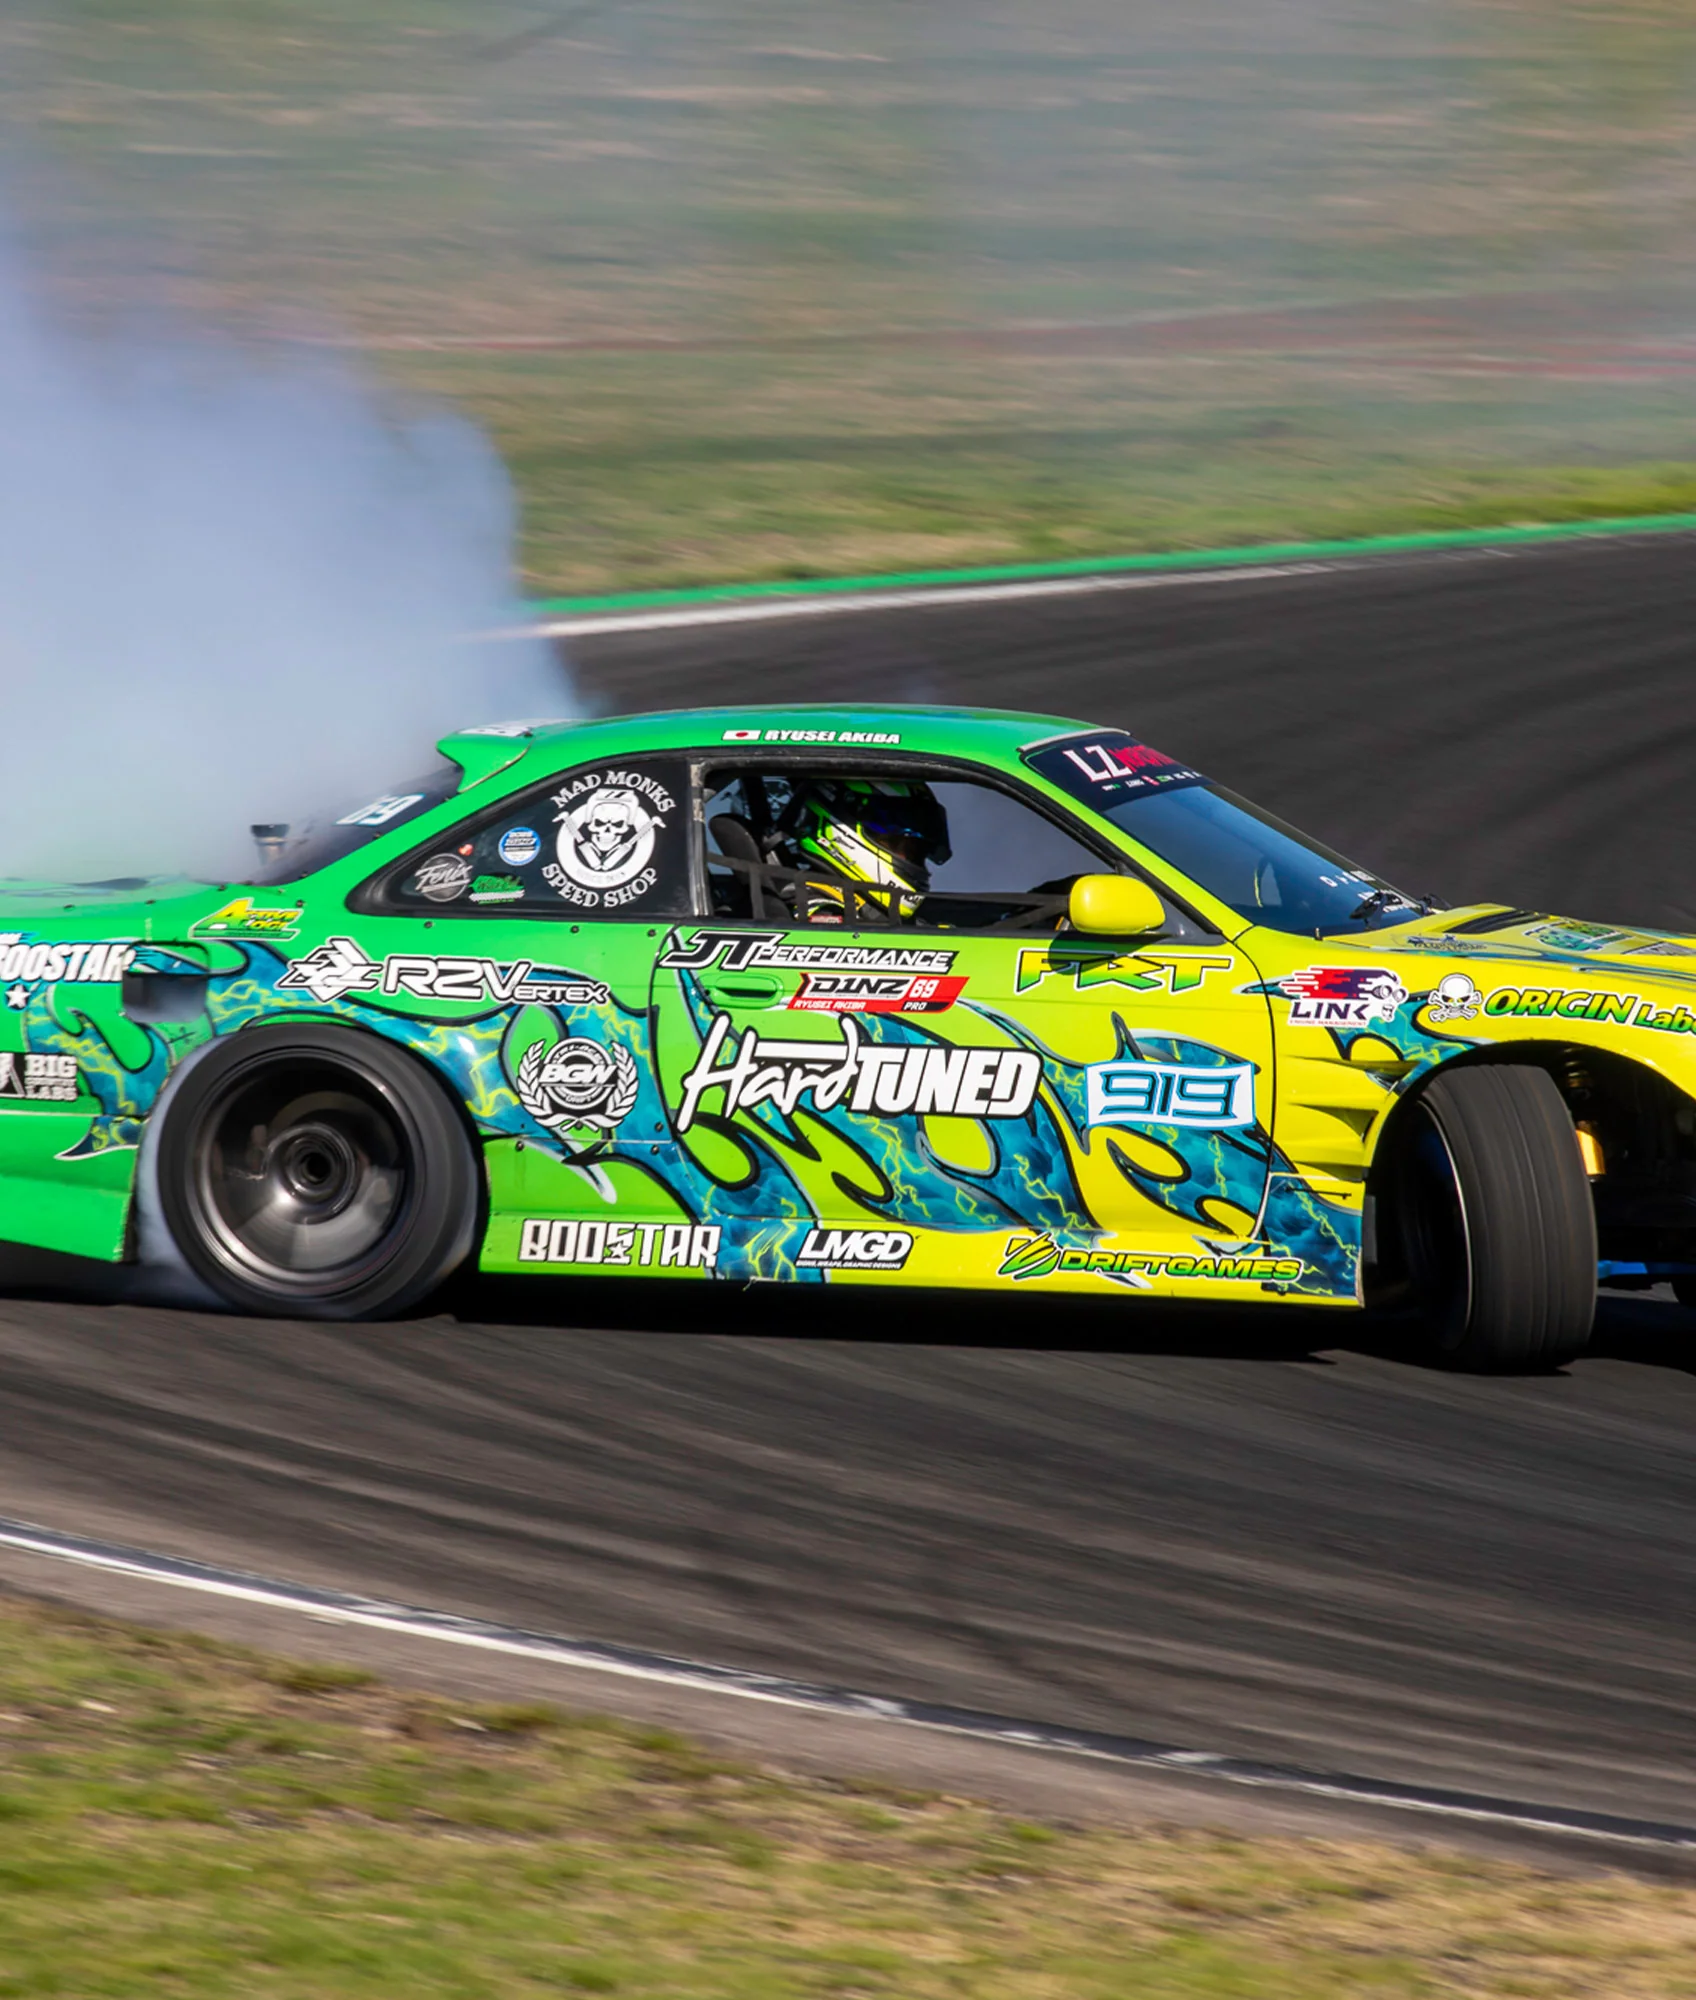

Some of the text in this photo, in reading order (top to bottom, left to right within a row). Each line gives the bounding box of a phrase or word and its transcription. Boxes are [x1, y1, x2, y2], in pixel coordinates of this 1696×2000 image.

[765, 730, 900, 744] RYUSEI AKIBA
[551, 770, 676, 813] MAD MONKS
[542, 862, 657, 908] SPEED SHOP
[757, 945, 954, 971] PERFORMANCE
[909, 979, 939, 998] 69
[793, 1000, 926, 1011] RYUSEI AKIBA PRO
[1291, 1001, 1370, 1020] LINK
[1484, 988, 1637, 1025] ORIGIN
[24, 1053, 78, 1078] BIG
[1099, 1070, 1240, 1119] 919
[519, 1219, 721, 1268] BOOSTAR
[799, 1230, 912, 1261] LMGD
